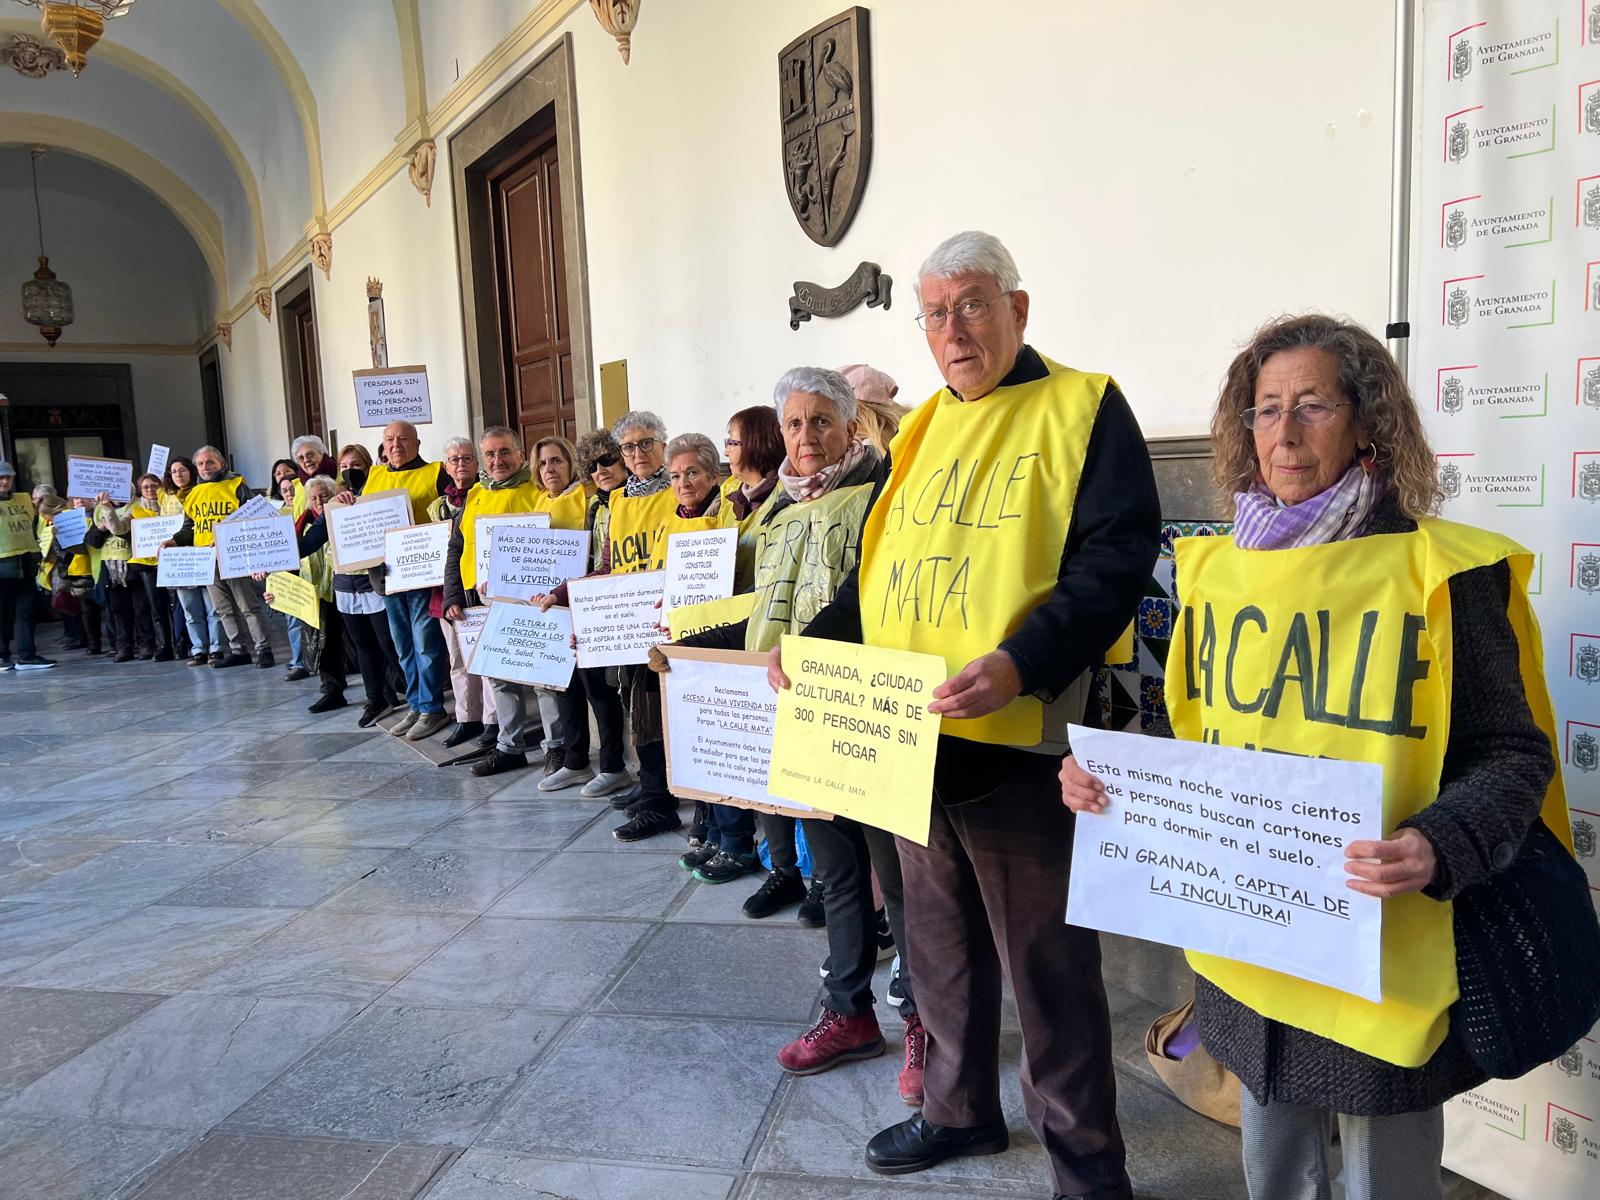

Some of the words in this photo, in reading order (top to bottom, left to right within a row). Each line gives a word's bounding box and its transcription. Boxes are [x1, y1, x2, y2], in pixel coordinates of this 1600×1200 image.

[912, 453, 1040, 528] CALLE
[230, 534, 257, 542] ACCESO
[703, 537, 726, 545] VIVIENDA
[226, 542, 262, 552] VIVIENDA
[265, 539, 288, 547] DIGNA
[397, 551, 440, 564] VIVIENDAS
[704, 549, 719, 557] PUEDE
[685, 561, 712, 569] CONSTRUIR
[690, 571, 718, 580] AUTONOMÍA
[637, 588, 664, 596] durmiend
[881, 556, 970, 630] MATA
[632, 600, 655, 608] cartones
[513, 619, 545, 627] CULTURA
[593, 625, 615, 633] PROPIO
[501, 627, 539, 639] ATENCIÓN
[801, 659, 863, 684] GRANADA,
[870, 672, 923, 693] ¿CIUDAD
[1185, 602, 1216, 708] LA
[1225, 603, 1431, 740] CALLE
[715, 686, 749, 697] Reclamamos
[683, 694, 705, 702] ACCESO
[730, 700, 762, 710] VIVIENDA
[795, 683, 865, 708] CULTURAL?
[872, 696, 898, 715] MÁS
[906, 704, 922, 721] DE
[700, 707, 712, 715] para
[715, 709, 729, 717] todas
[697, 717, 715, 727] Porque
[730, 722, 748, 730] CALLE
[794, 707, 814, 723] 300
[823, 713, 891, 740] PERSONAS
[898, 729, 918, 747] SIN
[705, 738, 741, 749] Ayuntamiento
[743, 744, 756, 752] debe
[832, 739, 877, 764] HOGAR
[700, 748, 723, 756] mediador
[724, 773, 744, 782] vivienda
[781, 768, 811, 782] Plataforma
[814, 776, 822, 785] LA
[825, 779, 845, 792] CALLE
[848, 786, 866, 797] MATA
[1087, 759, 1121, 777] Esta
[1128, 768, 1173, 787] misma
[1180, 778, 1224, 799] noche
[1231, 791, 1282, 811] varios
[1291, 801, 1361, 825] cientos
[1106, 784, 1123, 797] de
[1130, 790, 1193, 814] personas
[1200, 804, 1255, 830] buscan
[1263, 822, 1343, 848] cartones
[1124, 810, 1157, 825] para
[1163, 818, 1212, 842] dormir
[1220, 837, 1238, 850] en
[1246, 841, 1260, 855] el
[1269, 846, 1321, 869] suelo.
[1136, 848, 1225, 884] GRANADA,
[1235, 875, 1315, 906] CAPITAL
[1324, 899, 1349, 916] DE
[1150, 876, 1172, 893] LA
[1180, 882, 1292, 925] INCULTURA!
